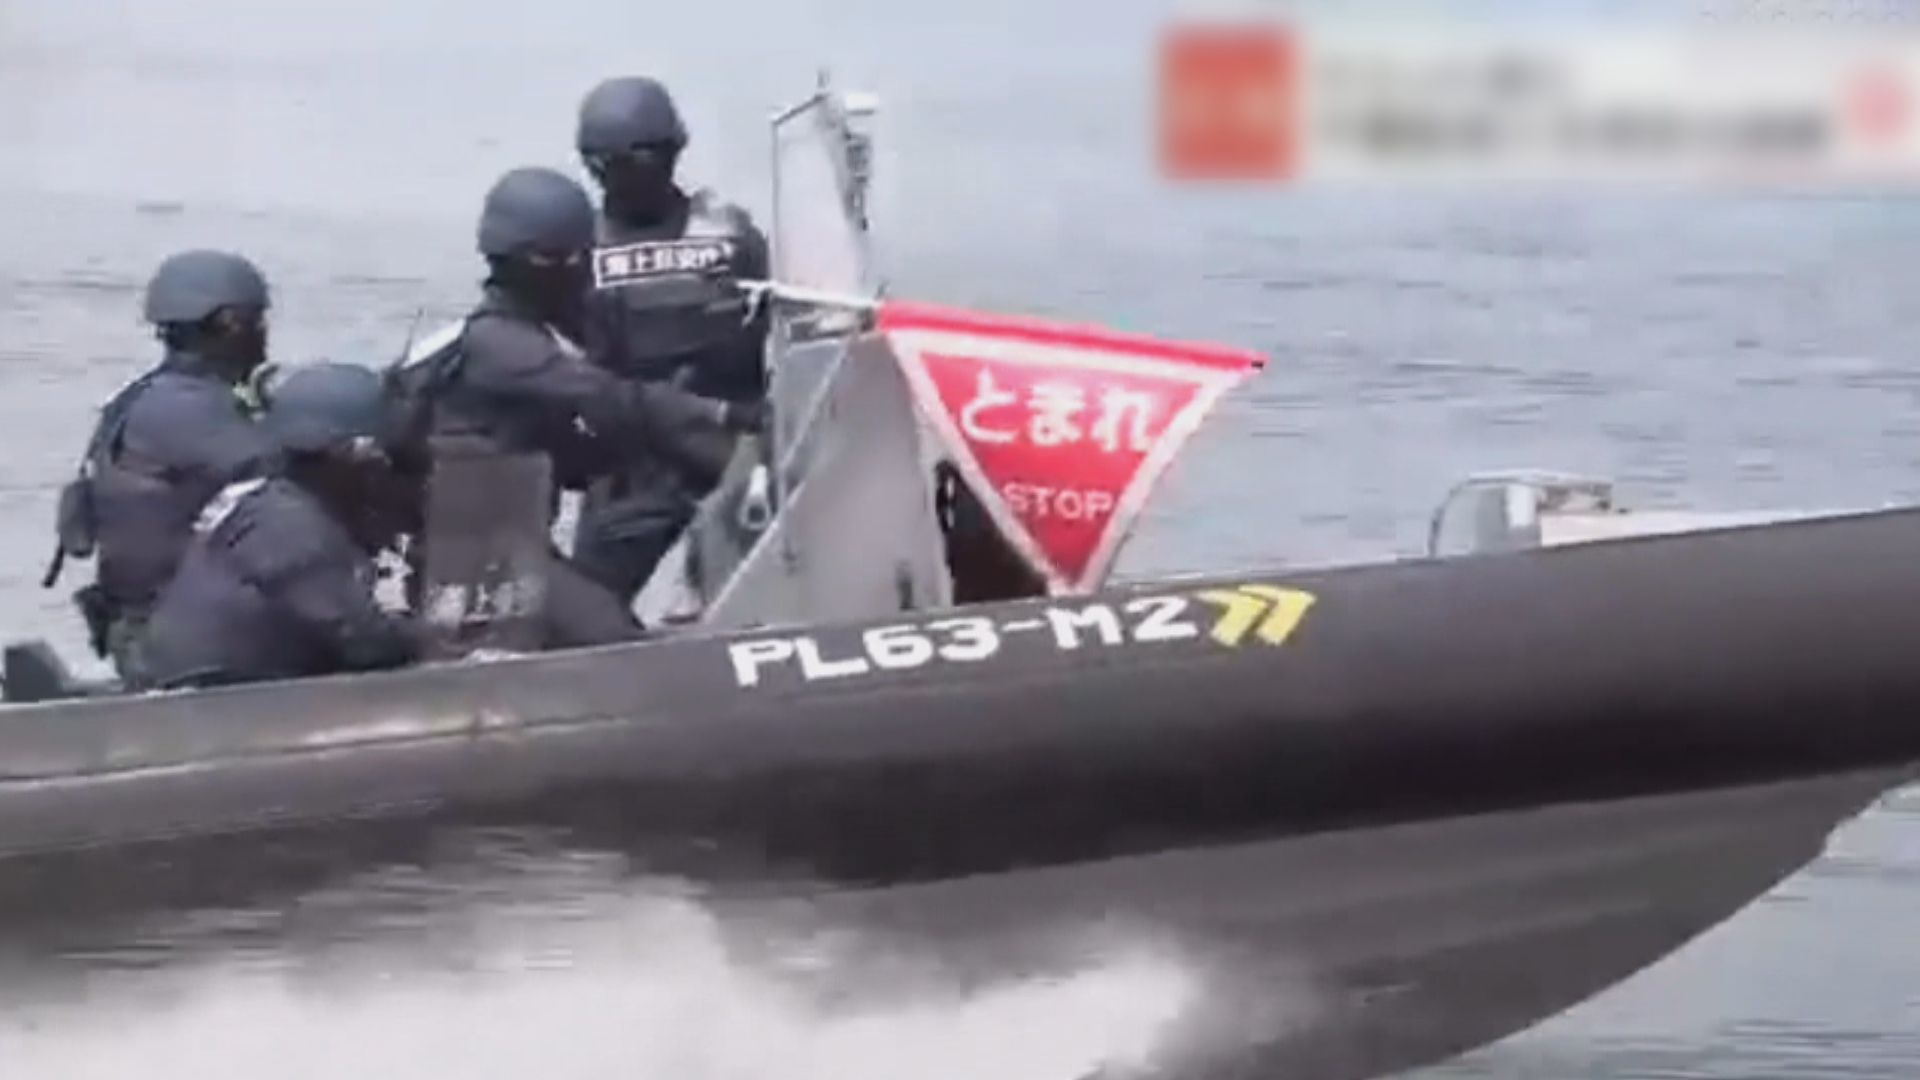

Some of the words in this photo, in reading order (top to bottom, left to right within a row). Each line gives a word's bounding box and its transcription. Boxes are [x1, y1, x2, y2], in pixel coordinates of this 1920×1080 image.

[960, 367, 1155, 452] とまれ
[1002, 481, 1114, 521] STOP
[727, 596, 1199, 687] PL63-M2
